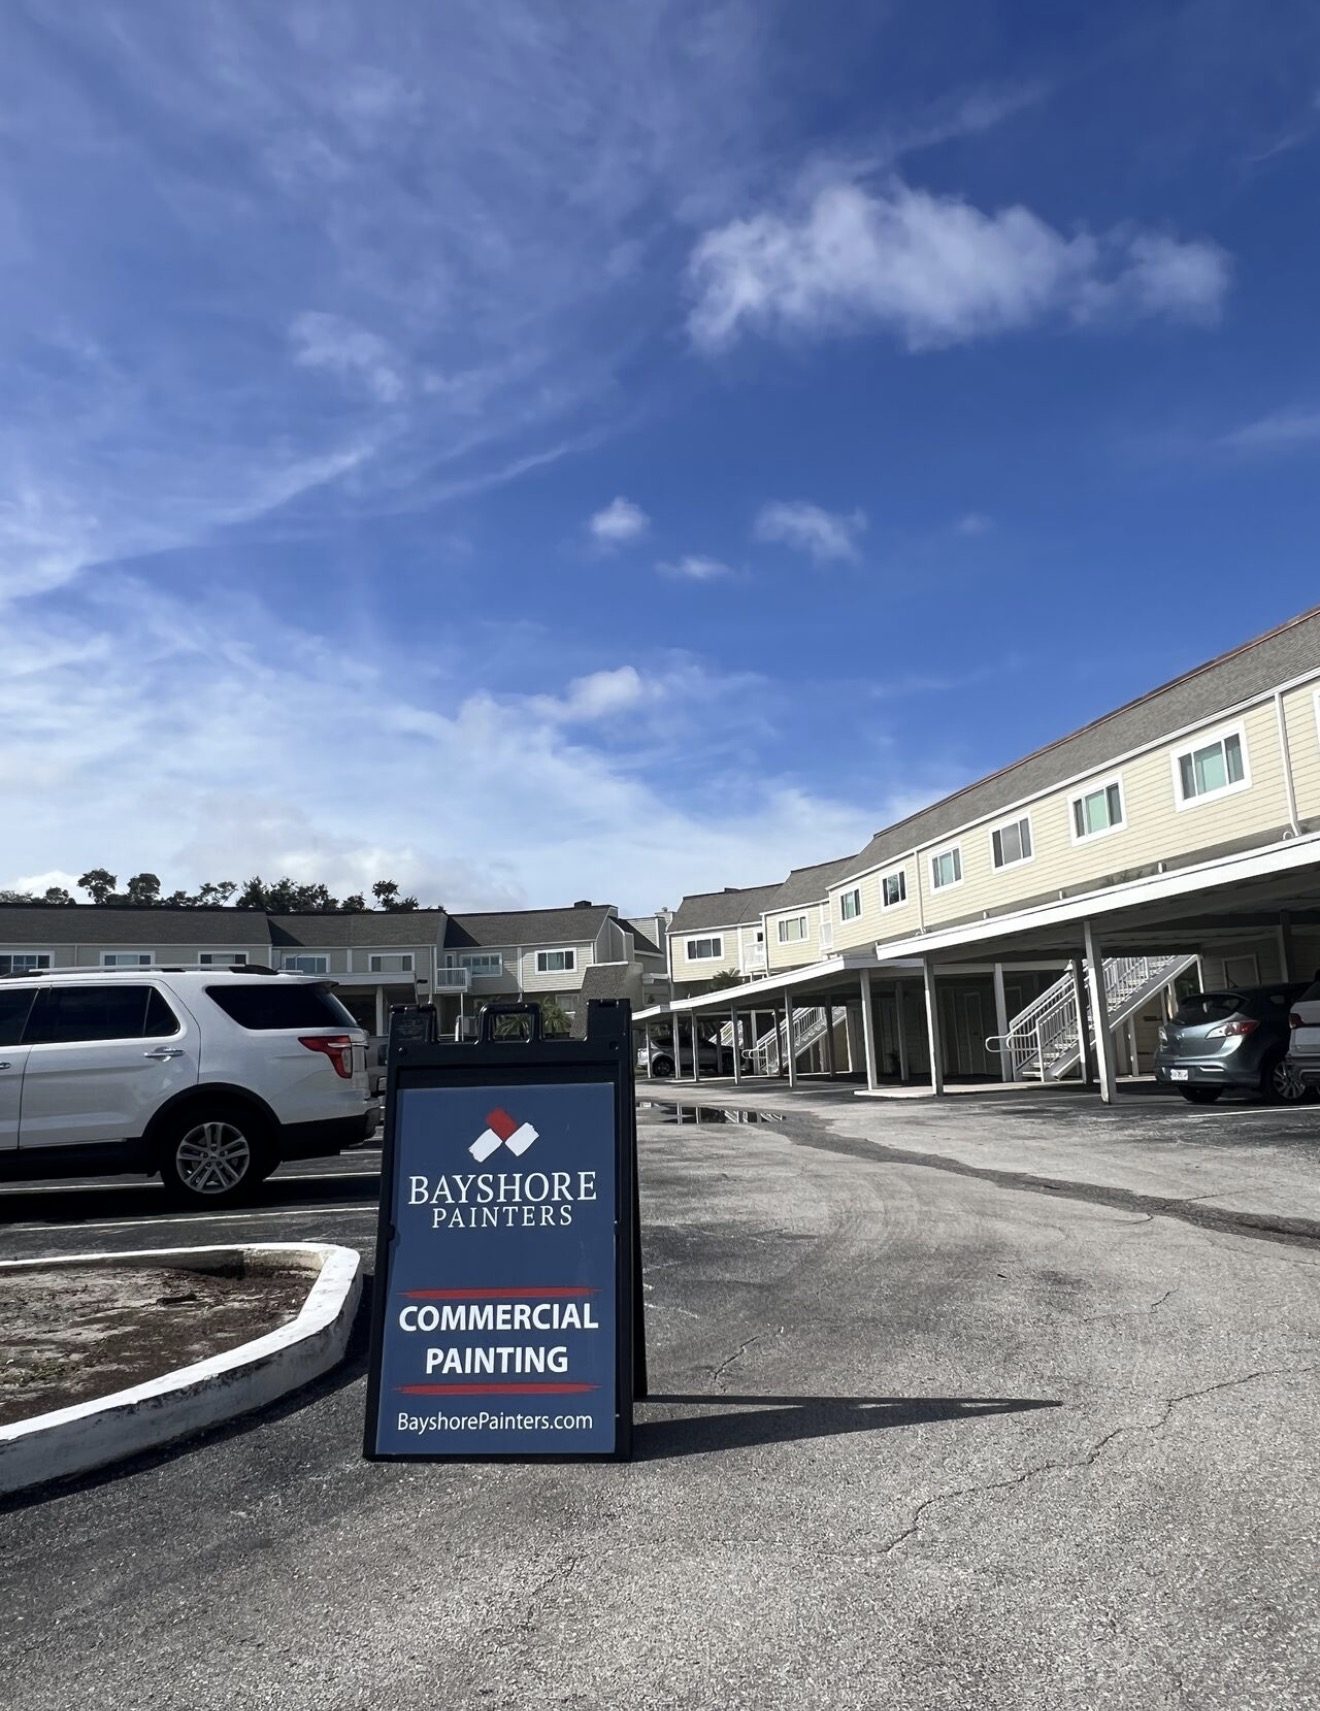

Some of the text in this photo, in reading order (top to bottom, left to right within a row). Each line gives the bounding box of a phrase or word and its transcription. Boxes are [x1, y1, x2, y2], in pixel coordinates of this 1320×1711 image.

[408, 1171, 597, 1204] BAYSHORE
[432, 1205, 572, 1228] PAINTERS
[398, 1303, 599, 1331] COMMERCIAL
[425, 1346, 568, 1374] PAINTING
[397, 1412, 593, 1435] BayshorePainters.com
